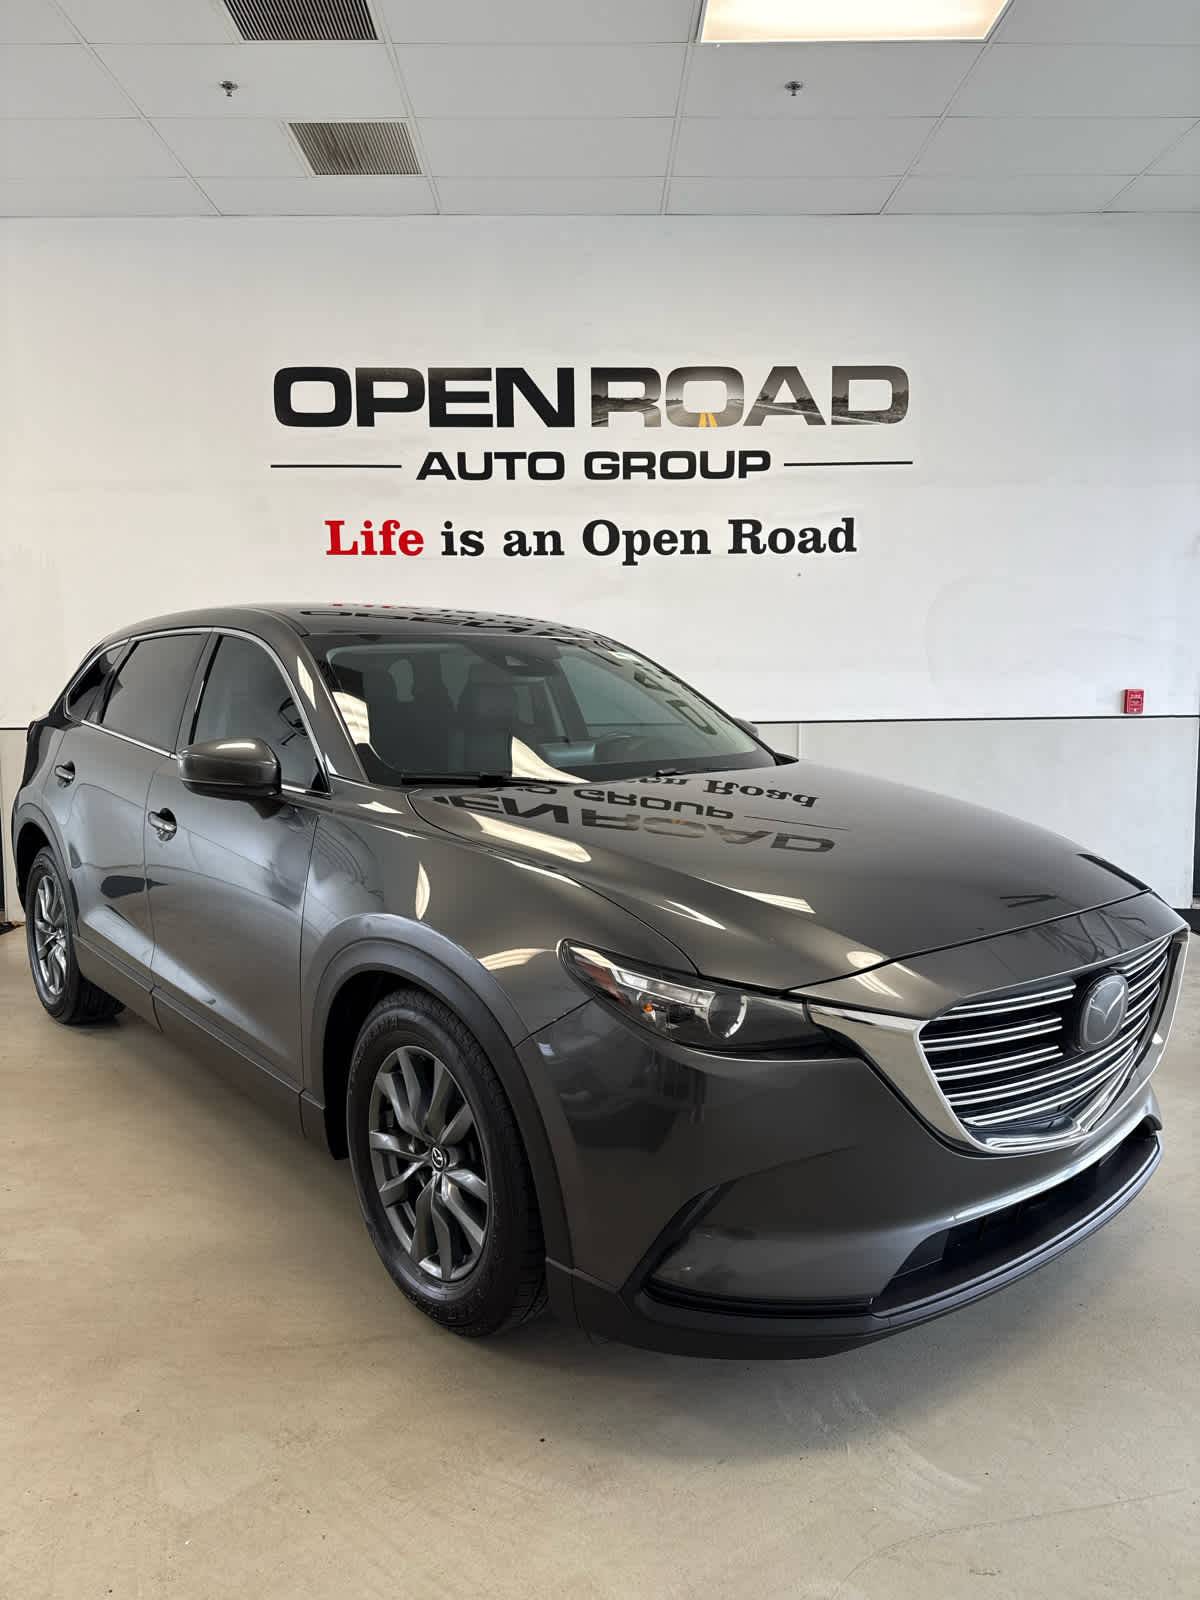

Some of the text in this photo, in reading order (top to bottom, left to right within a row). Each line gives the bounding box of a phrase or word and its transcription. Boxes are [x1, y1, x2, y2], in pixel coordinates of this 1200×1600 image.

[274, 366, 909, 427] OPEN ROAD
[416, 450, 770, 480] AUTO GROUP
[324, 518, 857, 566] Life is an Open Road
